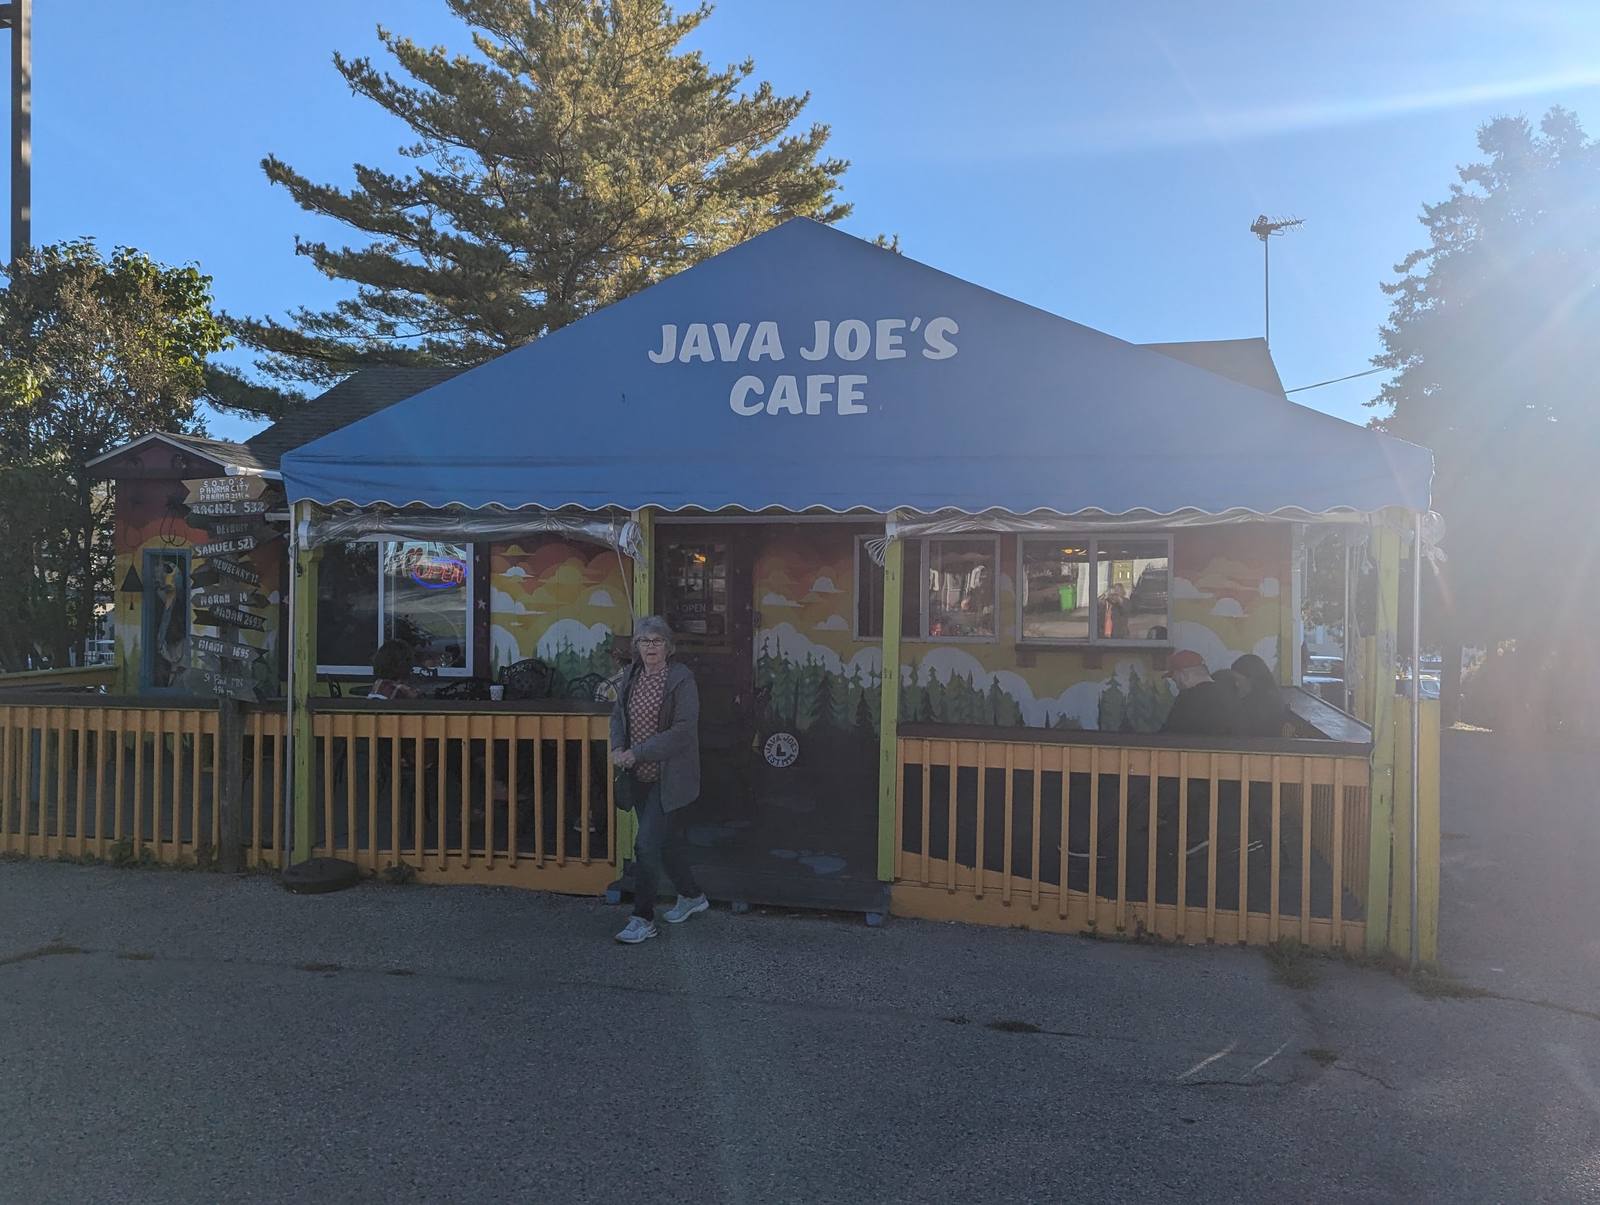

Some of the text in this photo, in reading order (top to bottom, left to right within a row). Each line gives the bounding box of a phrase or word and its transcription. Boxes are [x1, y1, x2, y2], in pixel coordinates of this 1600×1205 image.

[648, 316, 960, 363] JAVA JOE'S
[729, 374, 869, 416] CAFE
[231, 483, 250, 493] CITY
[195, 542, 237, 556] SAMUEL
[415, 562, 465, 583] OPEN
[682, 603, 706, 612] OPEN
